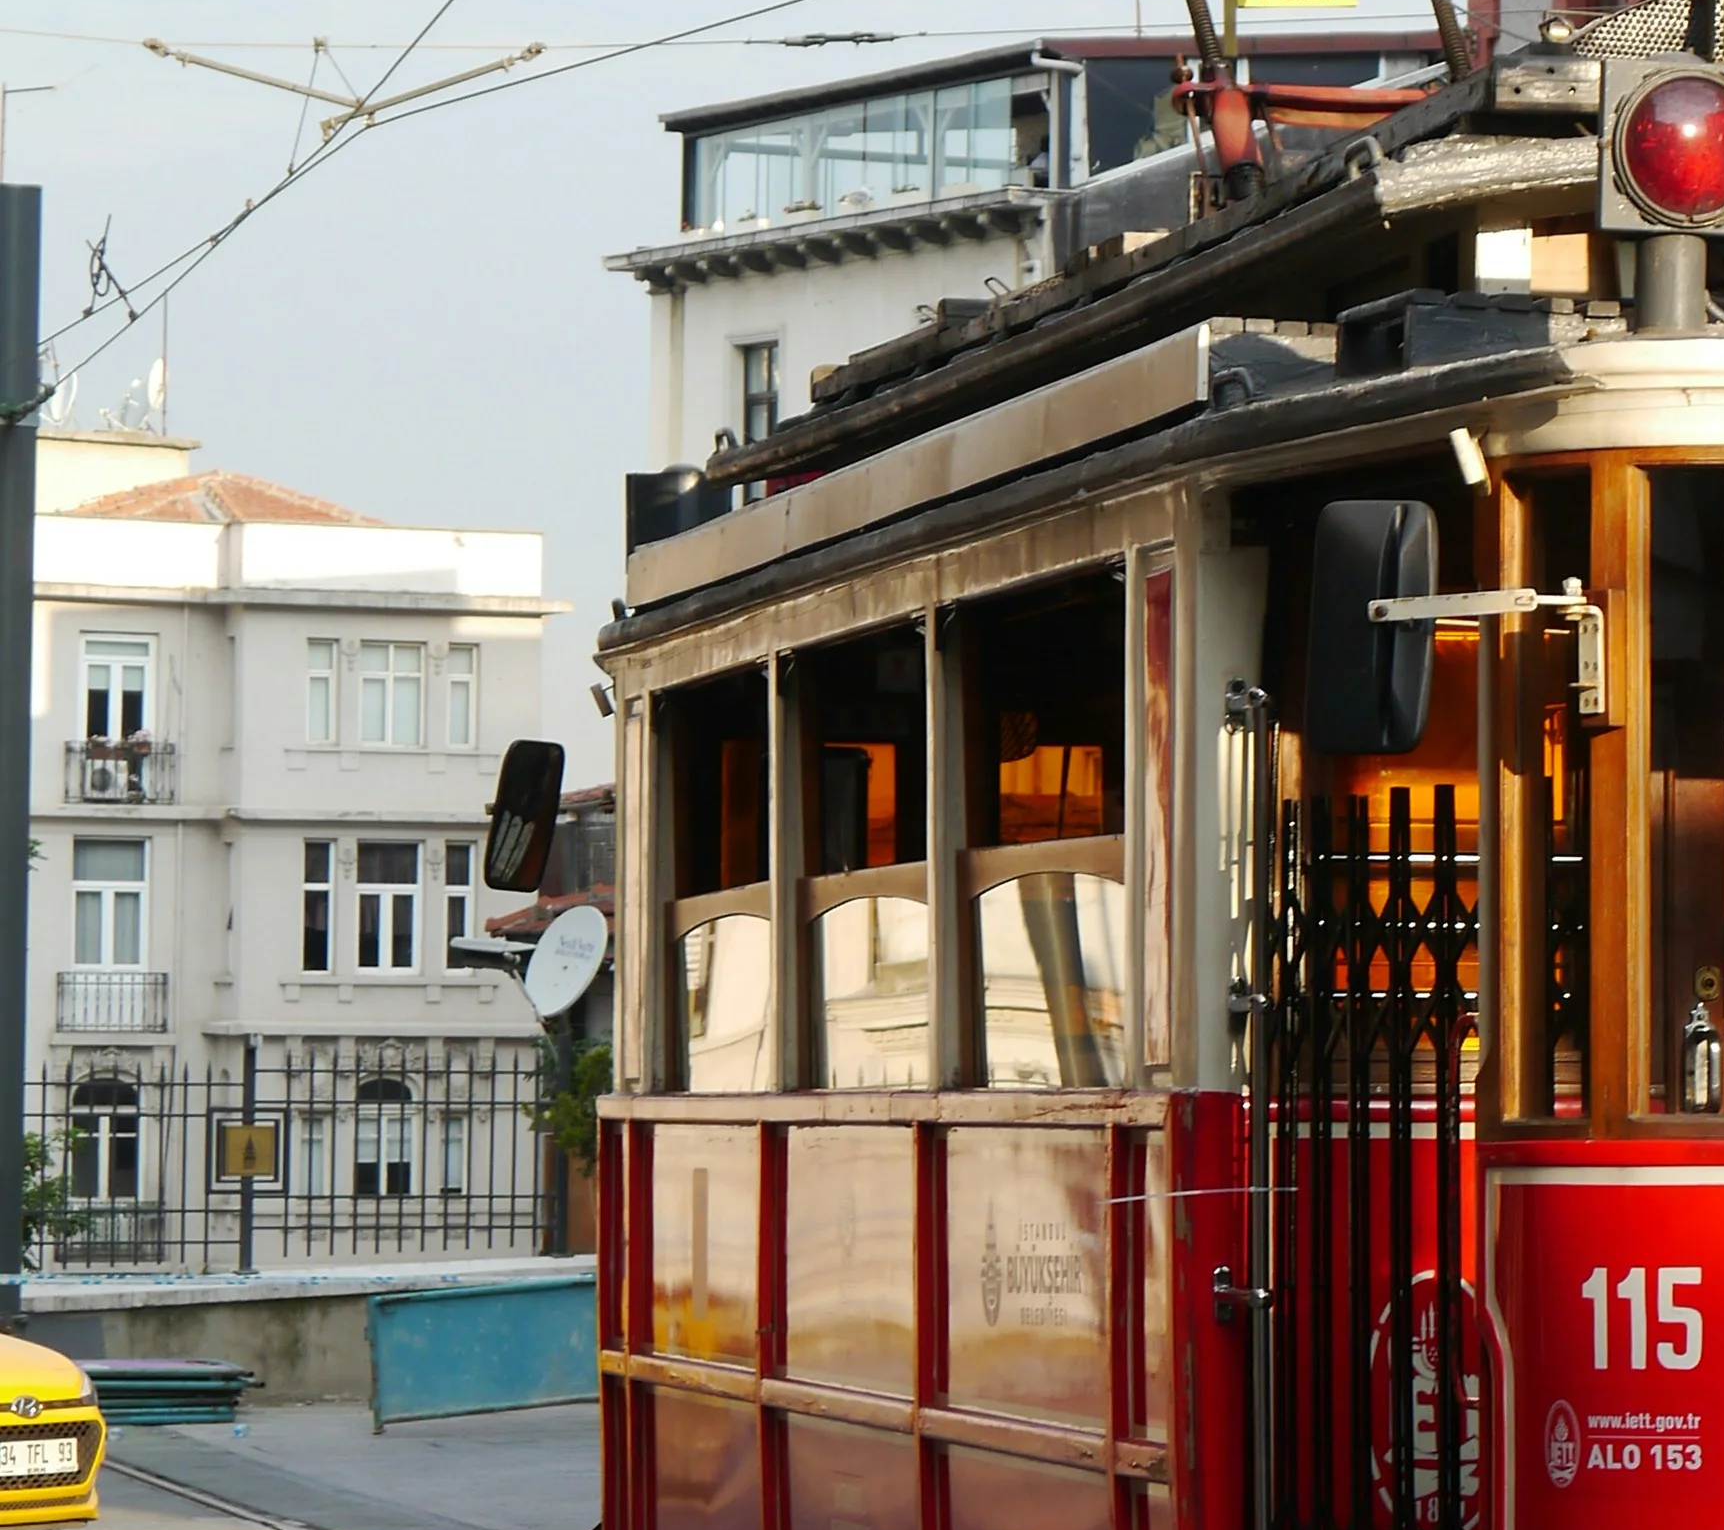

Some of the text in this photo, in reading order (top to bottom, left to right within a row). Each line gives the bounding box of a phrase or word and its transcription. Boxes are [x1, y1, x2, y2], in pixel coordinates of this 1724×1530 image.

[1580, 1266, 1704, 1371] 115
[1587, 1412, 1702, 1433] www.iett.gov.tr
[1, 1441, 73, 1466] 34 TFL 93
[1586, 1443, 1704, 1471] ALO 153
